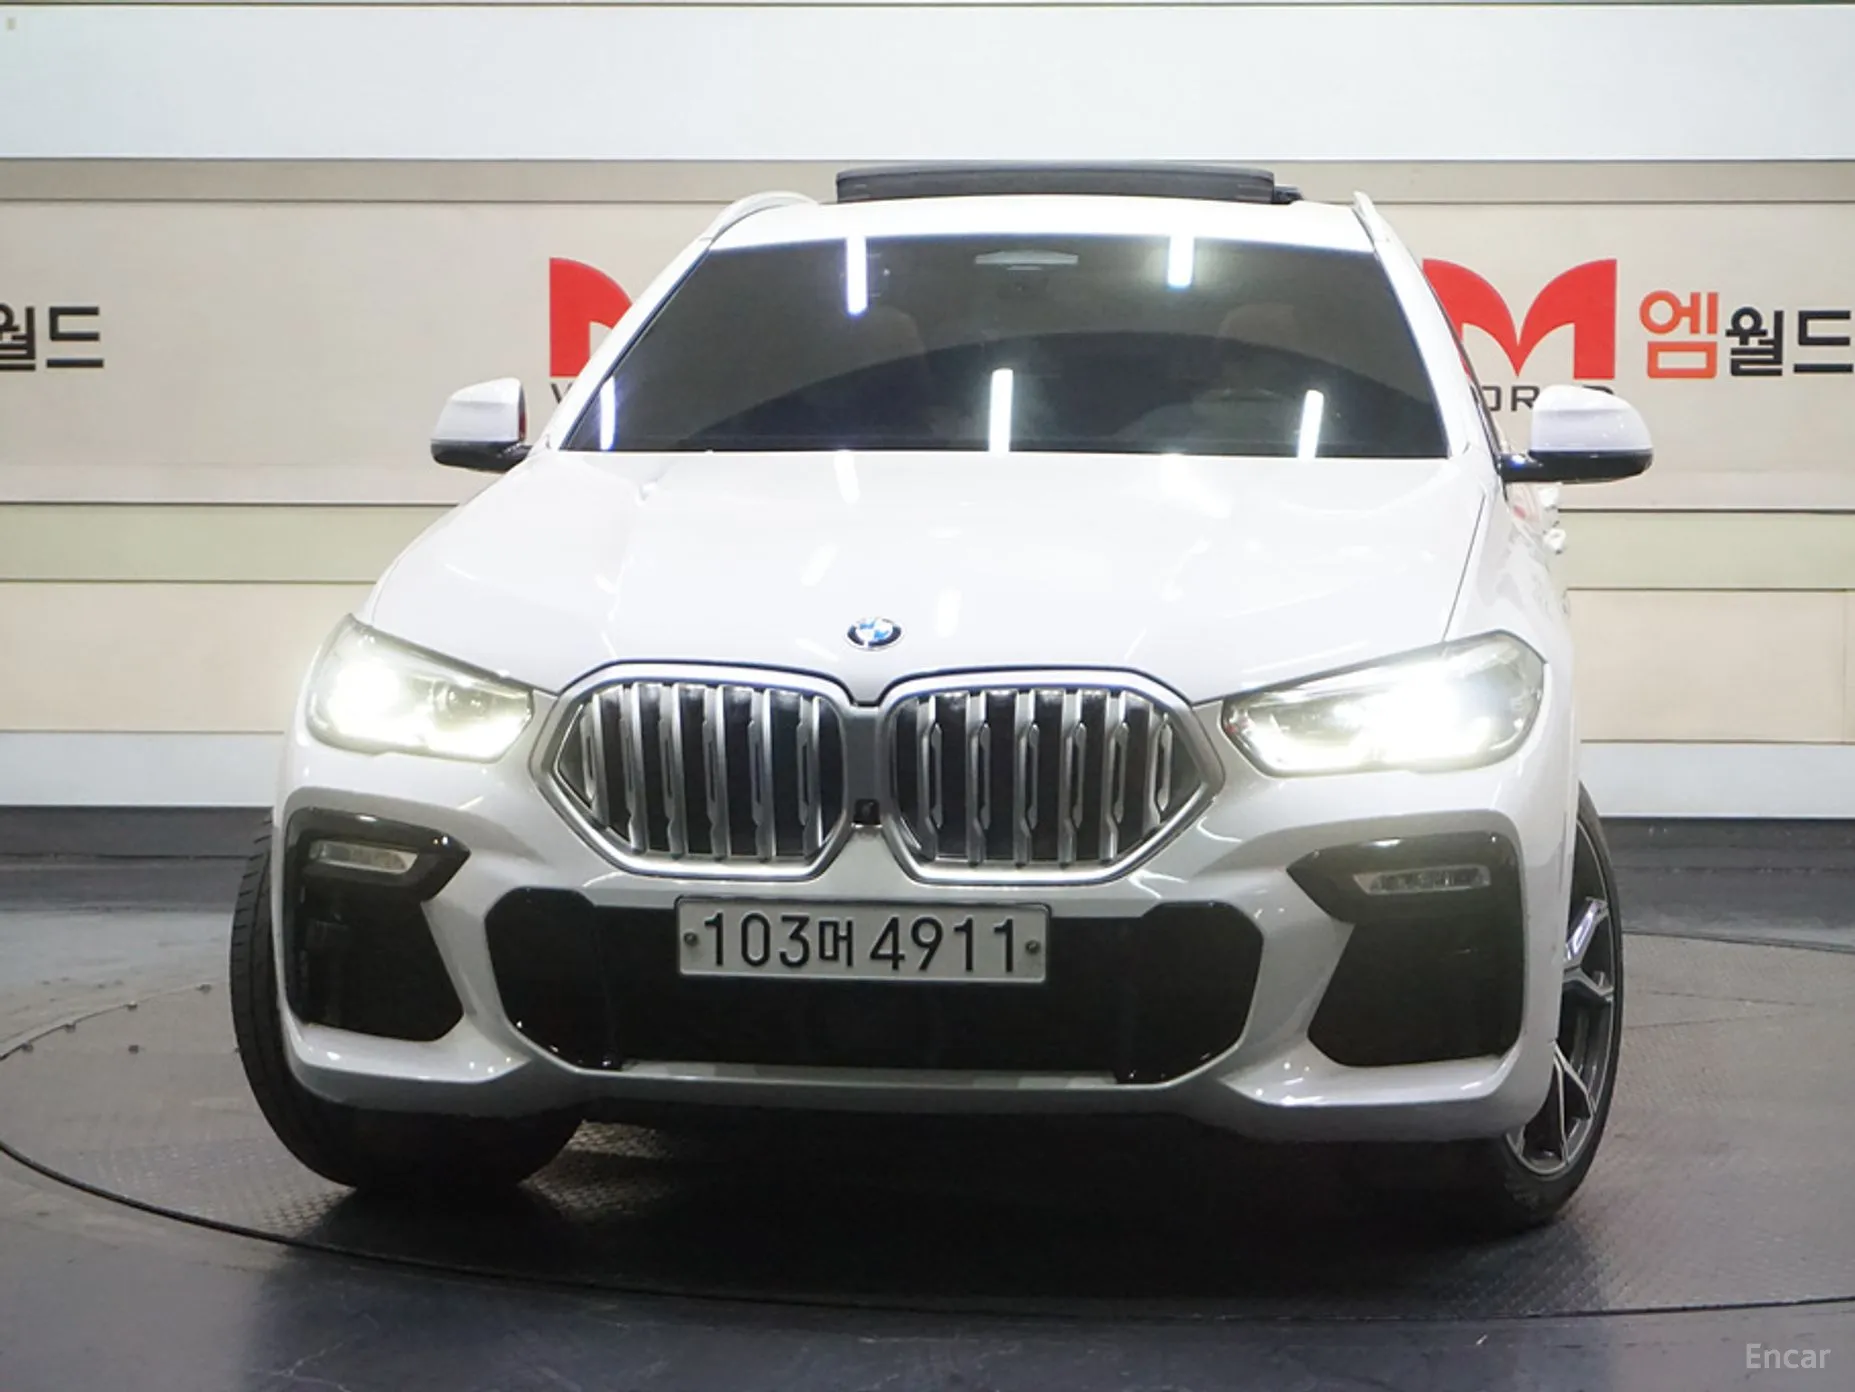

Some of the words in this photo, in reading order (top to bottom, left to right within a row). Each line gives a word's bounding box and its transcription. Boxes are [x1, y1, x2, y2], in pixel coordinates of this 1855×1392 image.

[1639, 289, 1854, 380] 엠월드
[704, 911, 854, 968] 103머
[869, 916, 1014, 973] 4911
